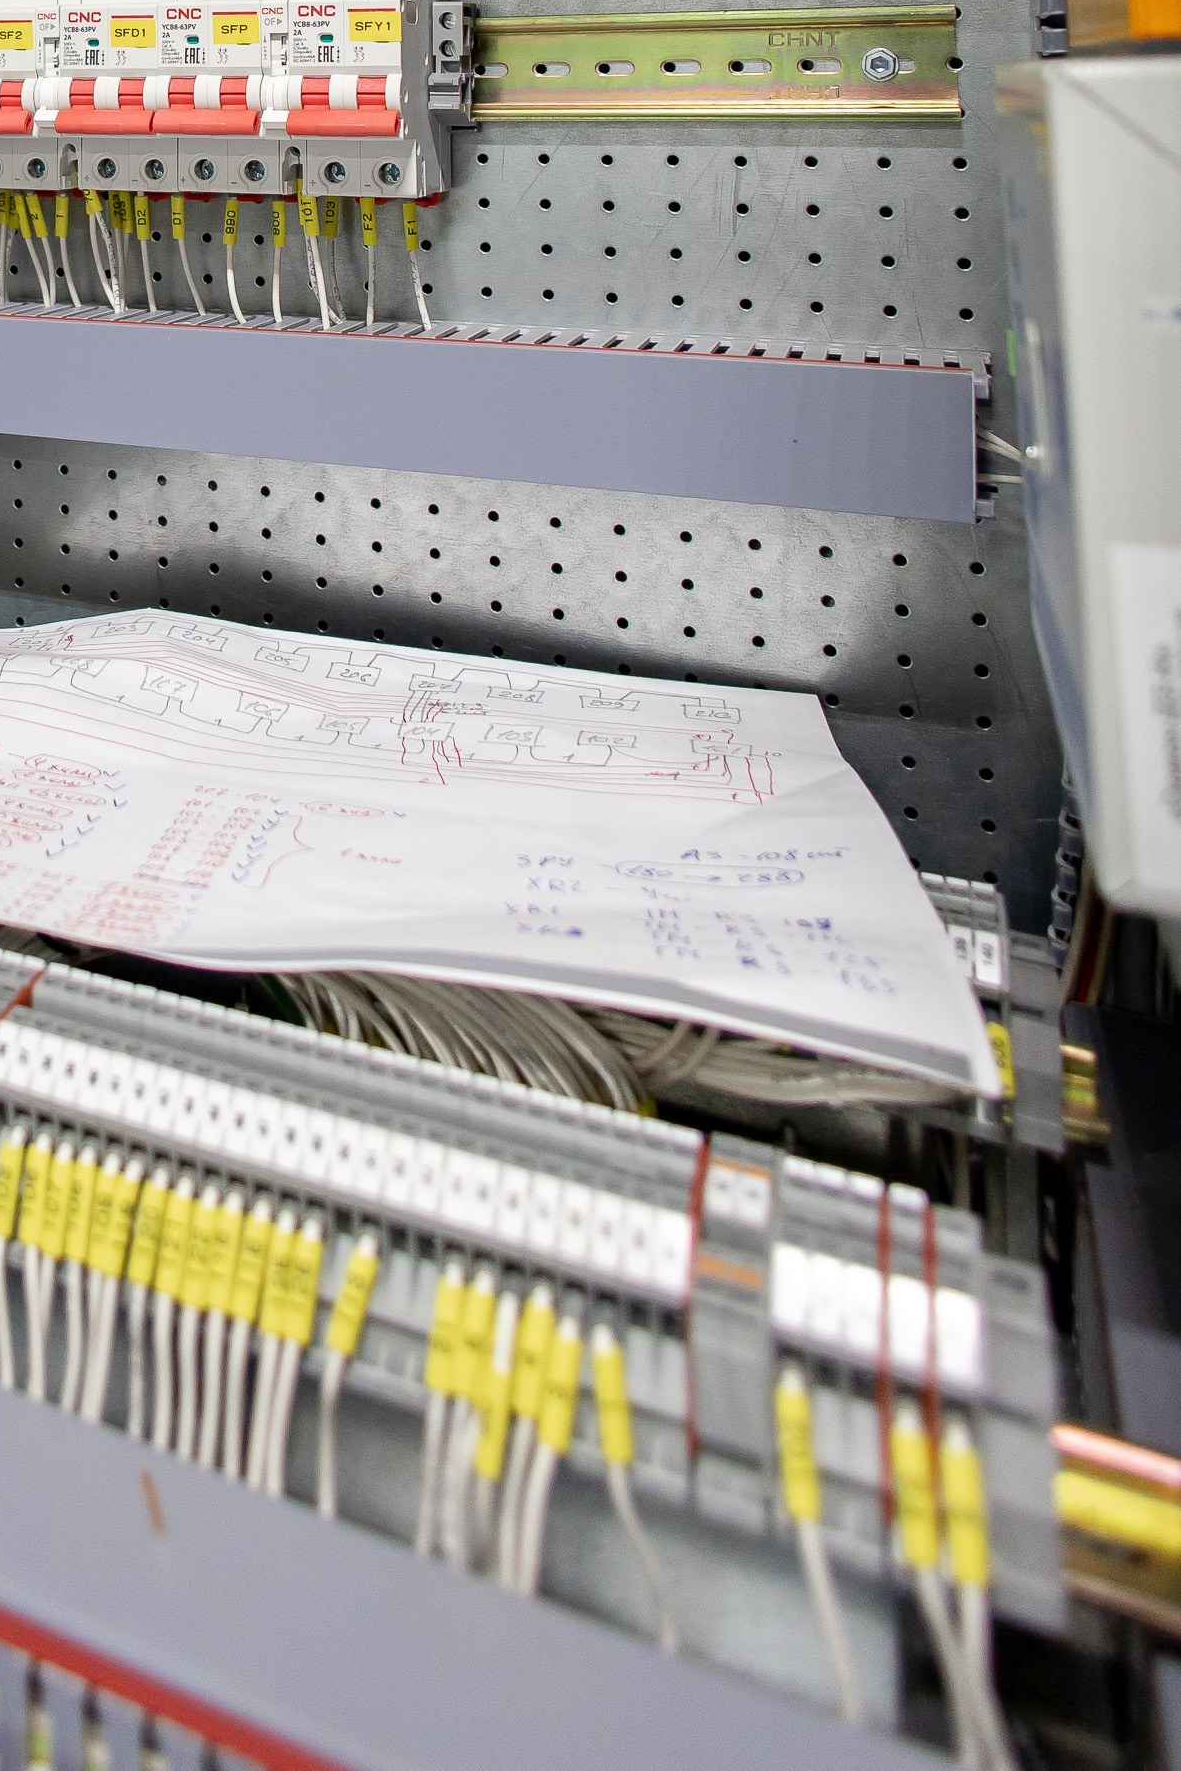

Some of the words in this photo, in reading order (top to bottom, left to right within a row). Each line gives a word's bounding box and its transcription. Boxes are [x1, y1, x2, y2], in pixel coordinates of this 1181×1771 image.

[36, 12, 57, 20] CNC
[165, 8, 202, 20] CNC
[261, 7, 284, 16] CNC
[296, 5, 336, 17] CNC
[67, 11, 102, 23] CNC
[63, 25, 97, 34] YCB8-63PV
[162, 23, 197, 32] YCB8-63PV
[220, 24, 249, 35] SFP
[292, 20, 331, 29] YCB8-63PV
[354, 21, 391, 31] SFY1
[0, 30, 23, 40] SF2
[113, 28, 146, 38] SFD1
[161, 31, 171, 39] 2A
[292, 29, 303, 37] 2A
[136, 209, 147, 226] D2
[325, 200, 336, 225] 103
[172, 211, 182, 226] D1
[272, 210, 281, 236] 900
[364, 213, 373, 231] F2
[407, 219, 417, 236] F1
[182, 629, 216, 646] 204
[339, 668, 372, 683] 206
